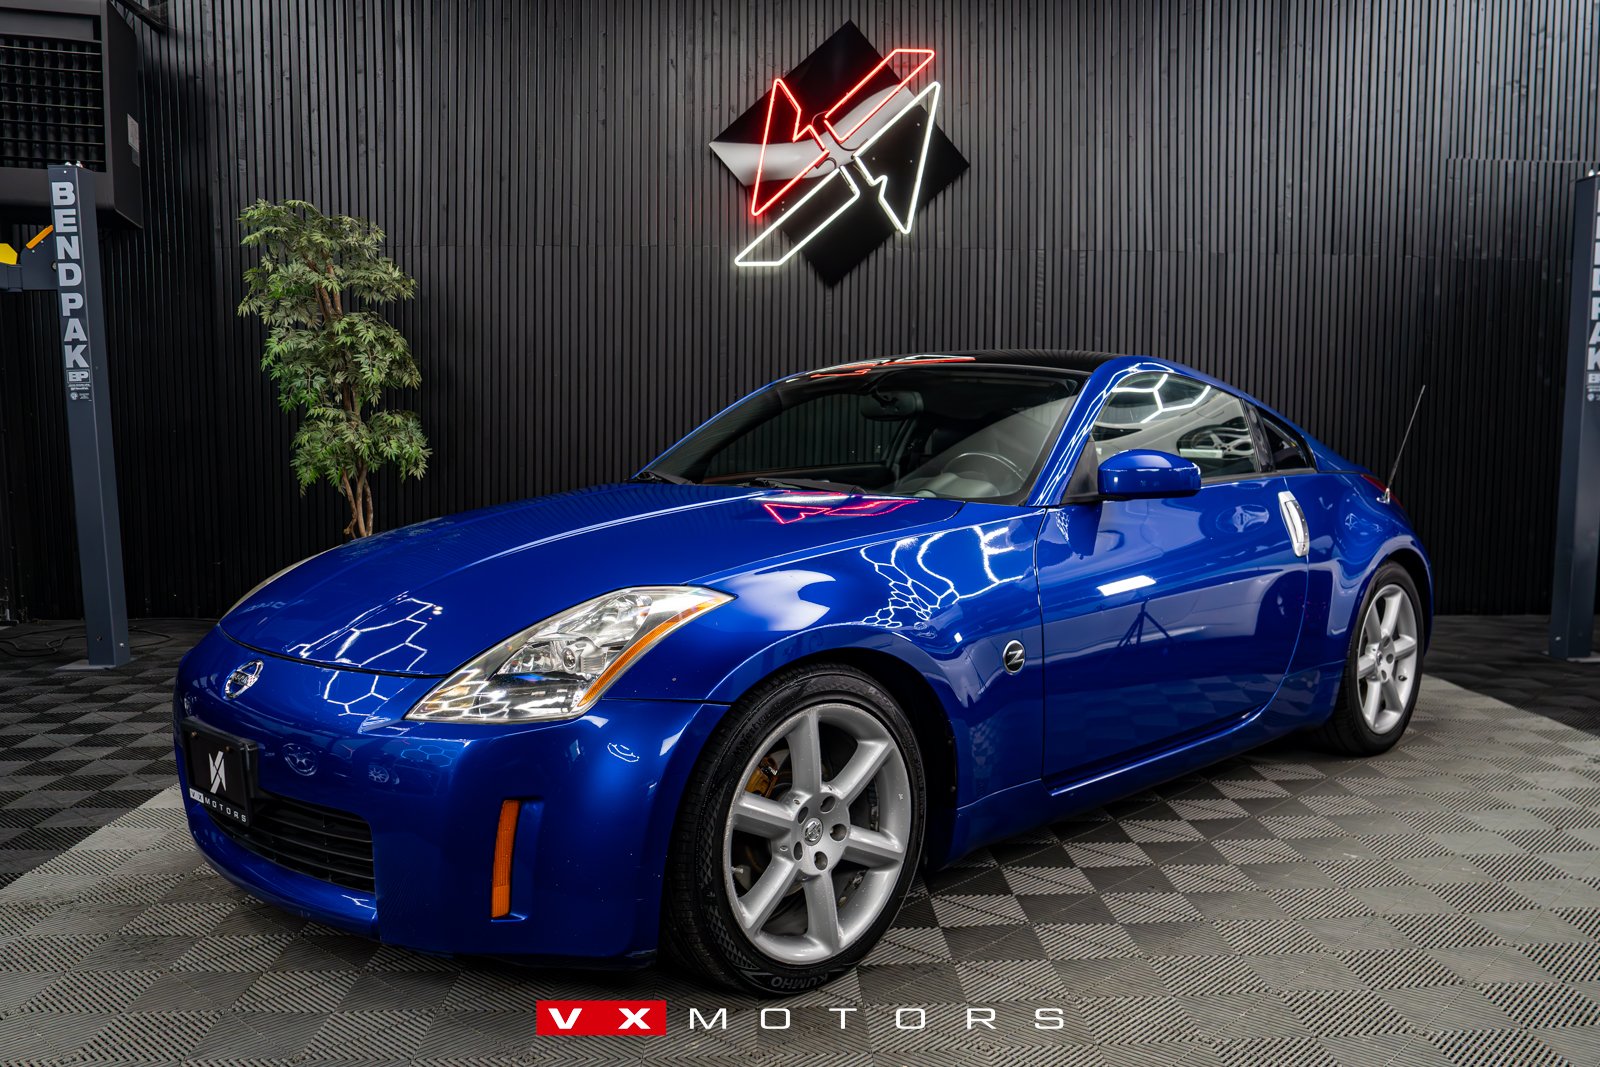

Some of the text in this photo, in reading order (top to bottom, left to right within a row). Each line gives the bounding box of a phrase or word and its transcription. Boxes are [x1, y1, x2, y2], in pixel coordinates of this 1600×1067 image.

[51, 181, 90, 368] BENDPAK
[68, 371, 89, 382] BP
[1006, 649, 1024, 666] Z
[204, 797, 247, 823] MOTORS
[770, 973, 829, 990] KUMHO
